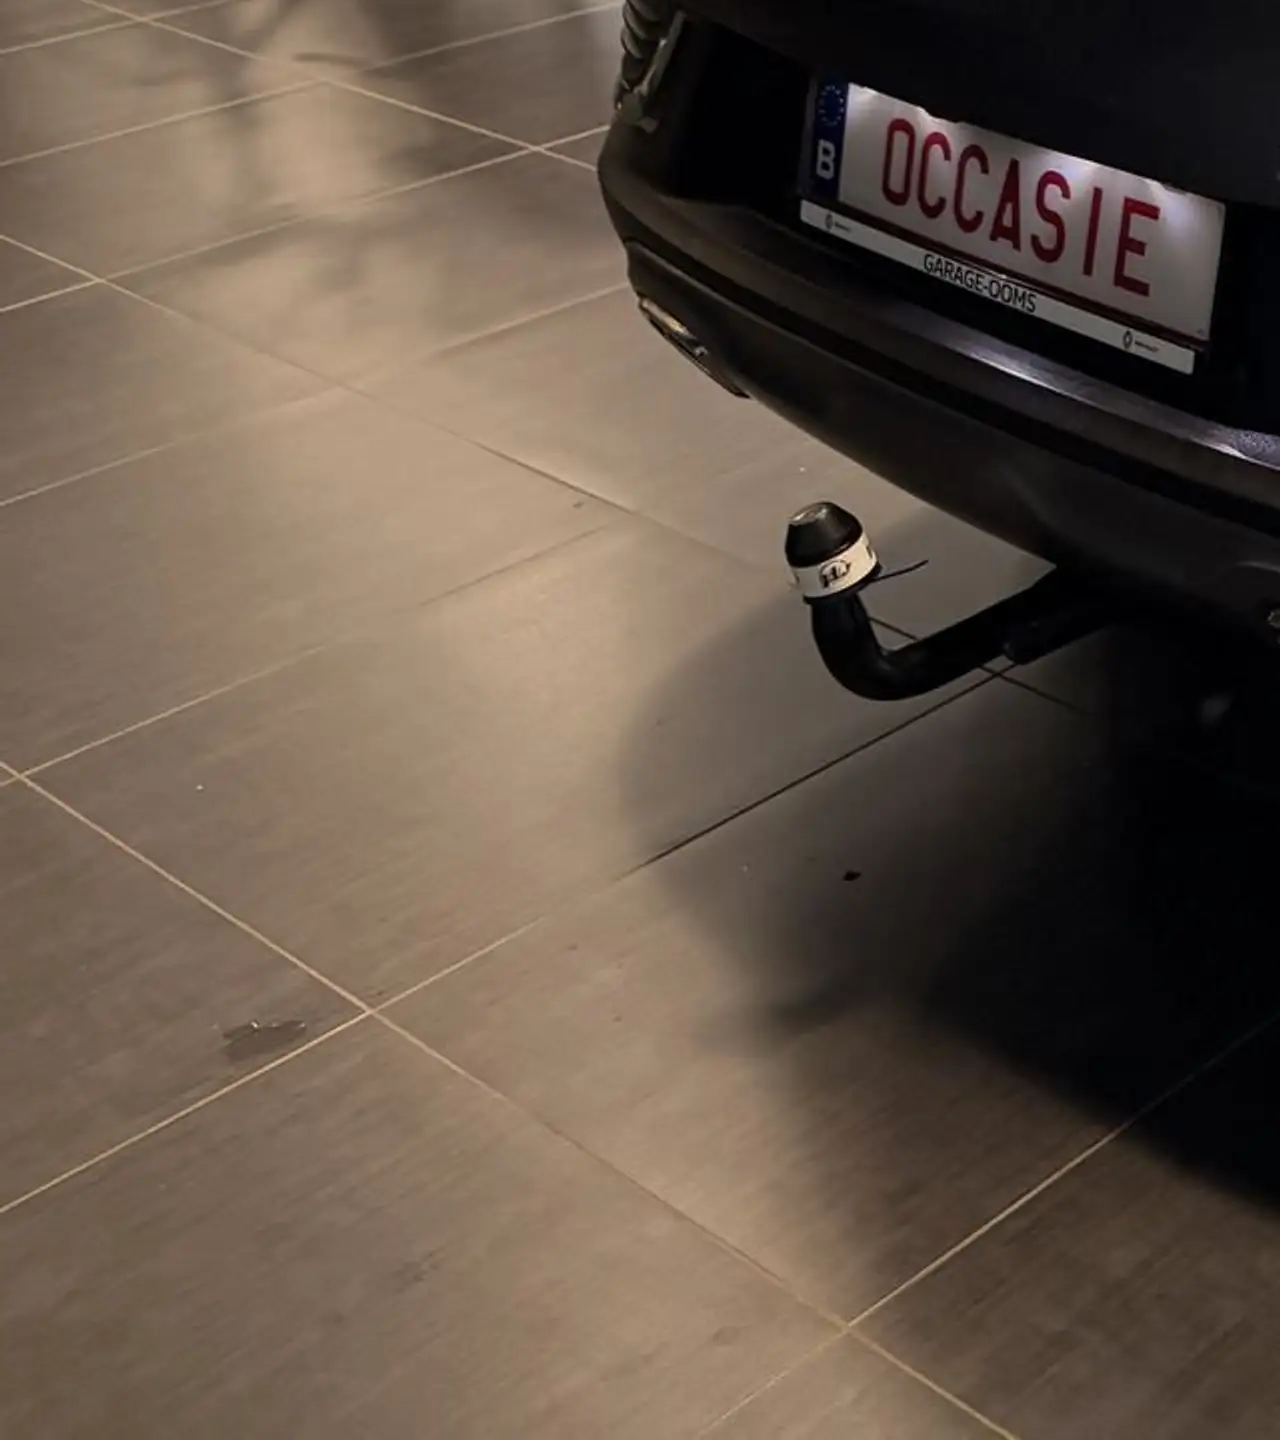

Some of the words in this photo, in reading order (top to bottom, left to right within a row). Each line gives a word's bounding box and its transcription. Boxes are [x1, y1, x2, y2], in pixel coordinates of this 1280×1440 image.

[816, 138, 837, 180] B
[881, 117, 1161, 298] OCCASIE
[922, 253, 1038, 315] GARAGE-OOMS
